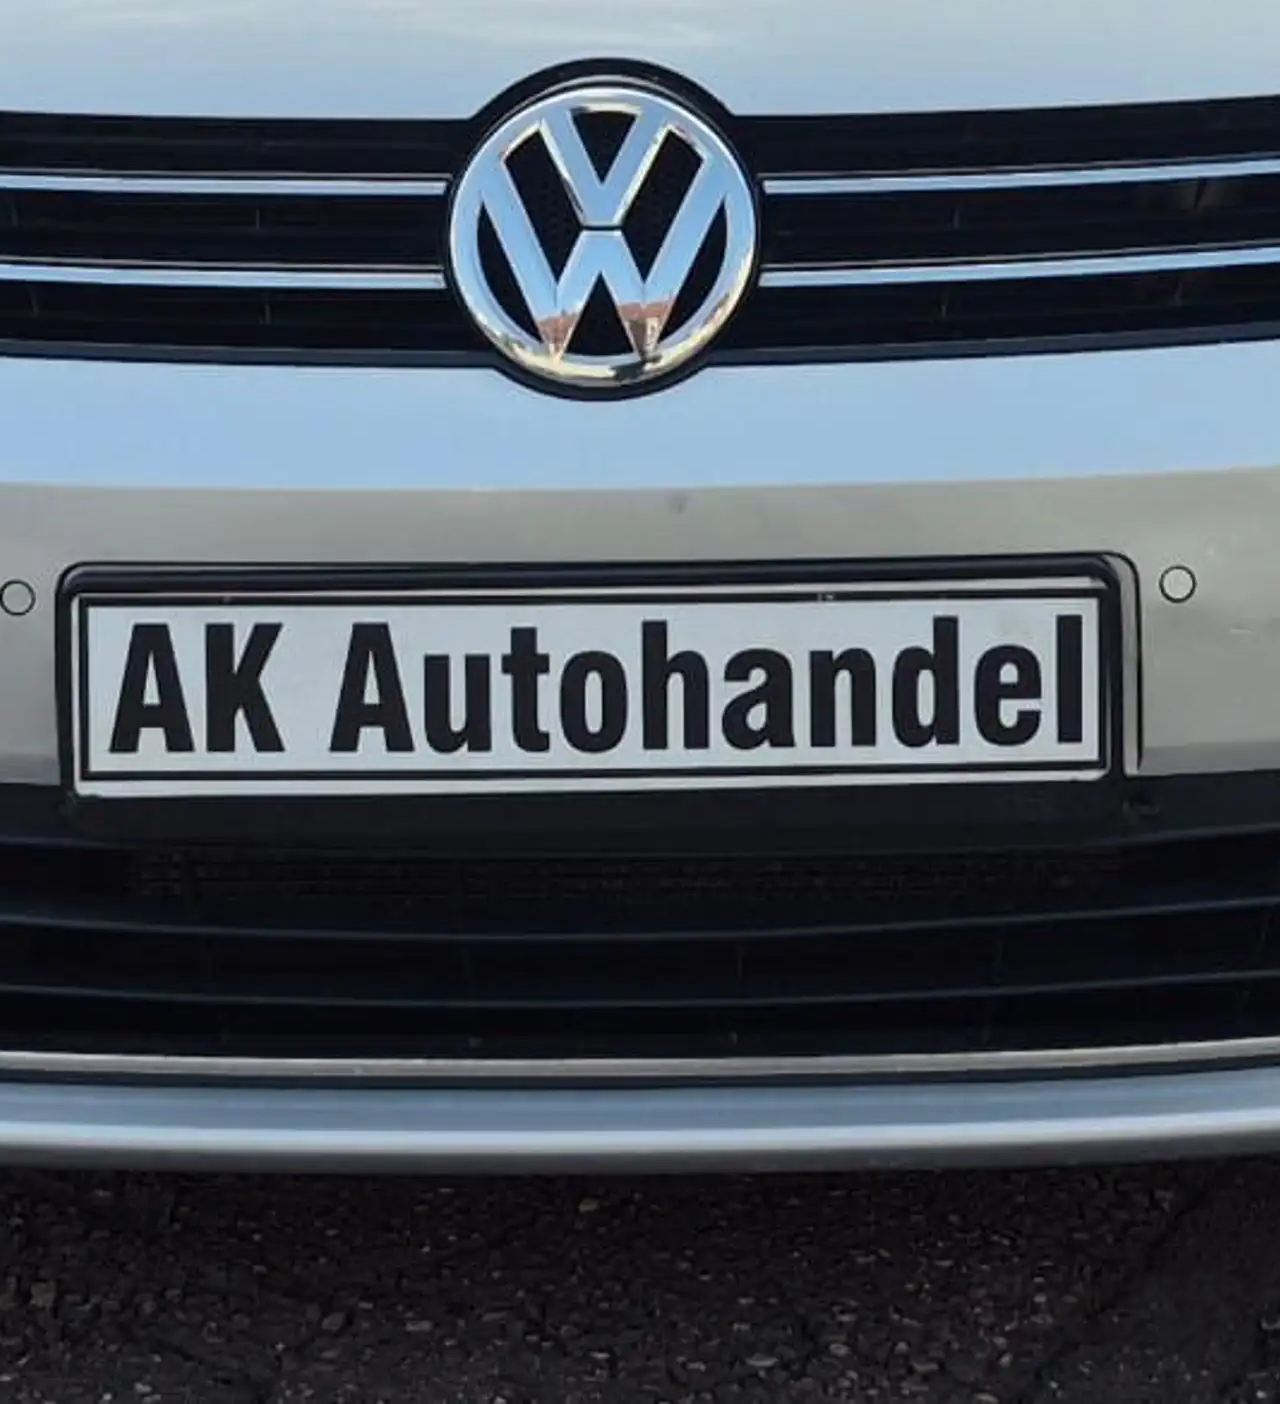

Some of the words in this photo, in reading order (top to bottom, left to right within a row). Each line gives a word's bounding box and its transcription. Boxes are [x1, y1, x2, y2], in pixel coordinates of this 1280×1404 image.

[466, 96, 736, 370] VW
[108, 622, 286, 754] AK
[328, 614, 1084, 754] Autohandel
